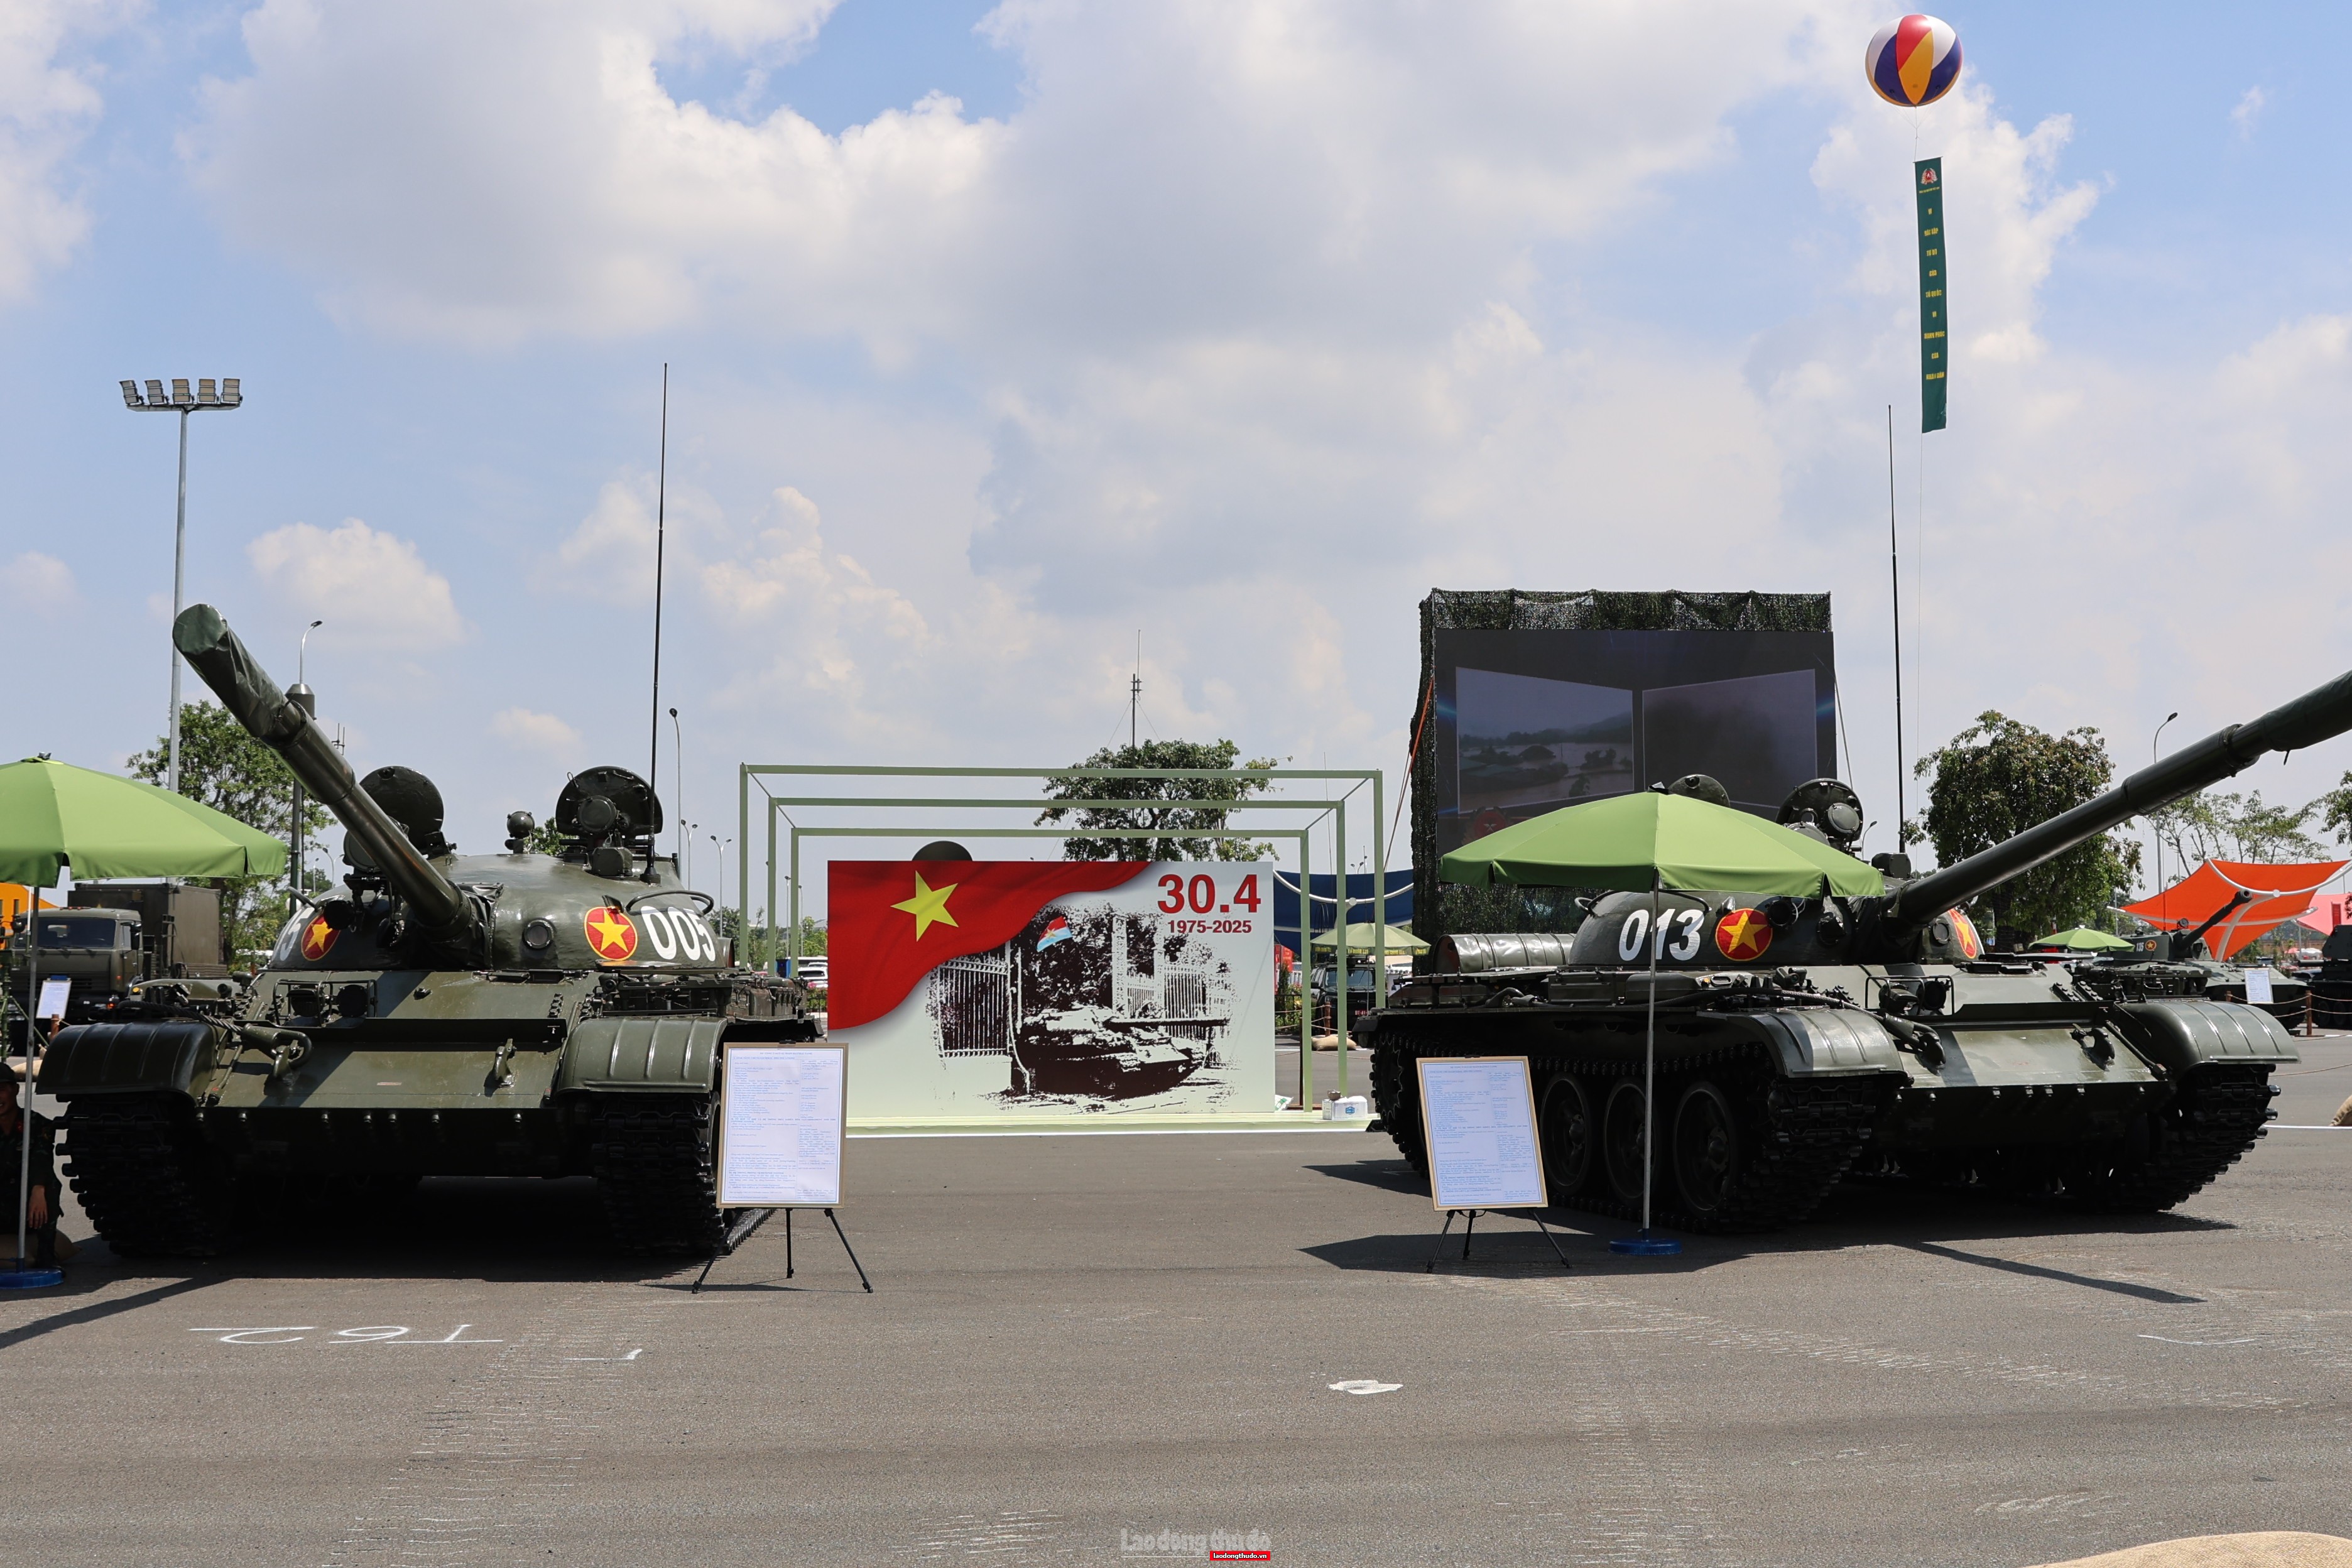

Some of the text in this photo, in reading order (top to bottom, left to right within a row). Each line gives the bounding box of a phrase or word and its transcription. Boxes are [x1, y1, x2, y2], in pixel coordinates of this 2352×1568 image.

[1157, 874, 1261, 914] 30.4
[640, 905, 716, 962] 005
[1168, 920, 1252, 934] 1975-2025
[1619, 908, 1704, 961] 013
